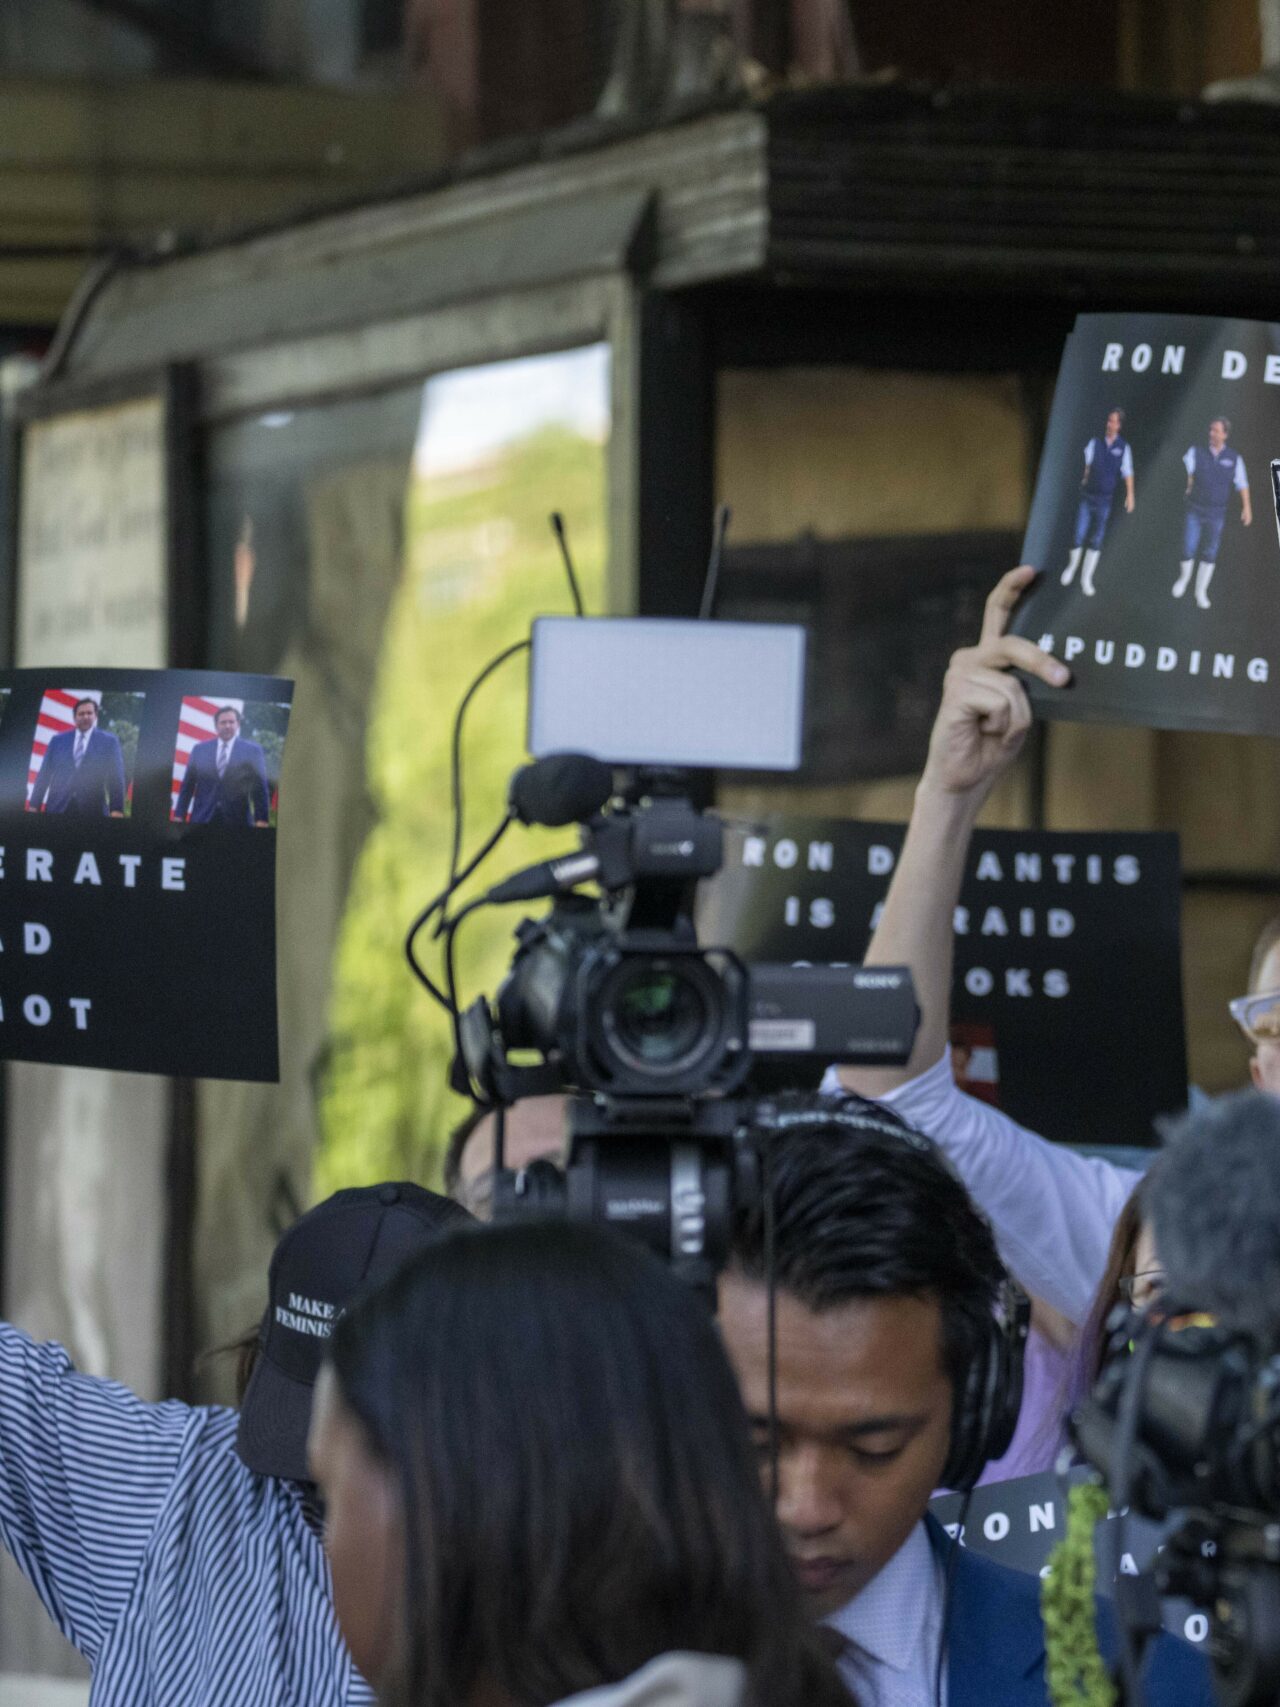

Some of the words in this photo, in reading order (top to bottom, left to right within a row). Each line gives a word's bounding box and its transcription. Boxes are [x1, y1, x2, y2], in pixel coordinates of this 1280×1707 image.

[1101, 342, 1186, 376] RON
[0, 846, 186, 891] RATE
[743, 836, 834, 873] RON
[867, 844, 1141, 886] DANTIS
[784, 896, 835, 928] IS
[0, 993, 92, 1030] OT
[275, 1304, 335, 1338] FEMINIS
[288, 1291, 335, 1320] MAKE
